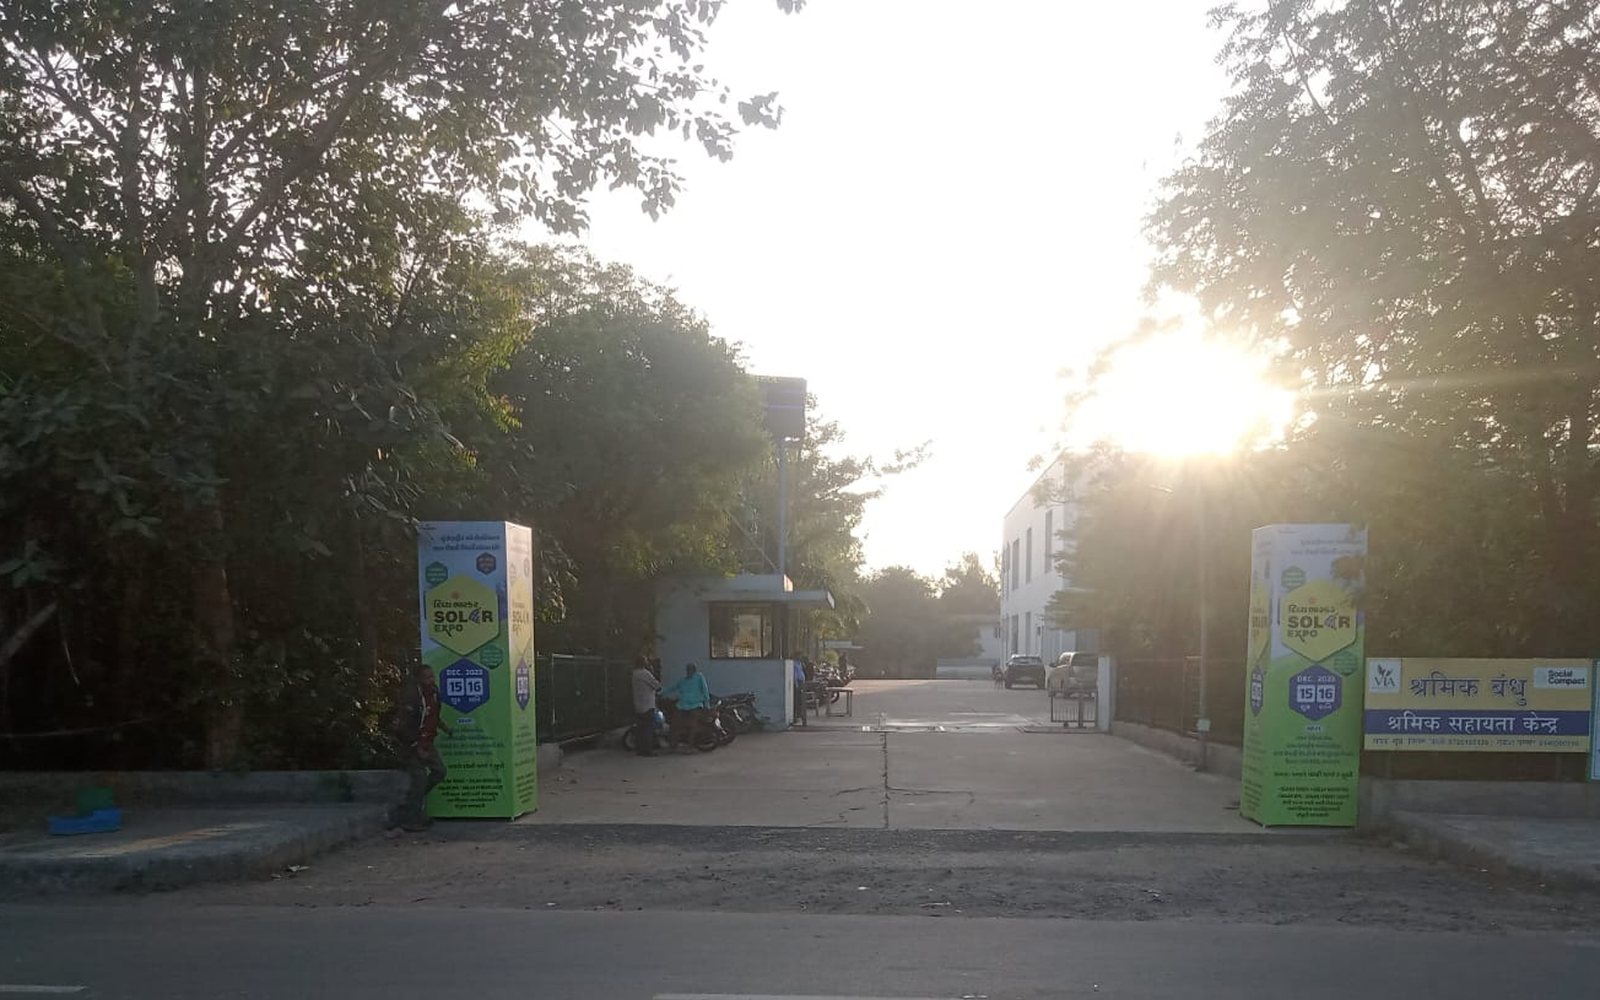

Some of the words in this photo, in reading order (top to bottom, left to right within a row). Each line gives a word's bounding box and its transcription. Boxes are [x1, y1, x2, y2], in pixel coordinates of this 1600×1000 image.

[434, 622, 464, 637] EXPO
[1287, 629, 1318, 642] EXPO
[1547, 669, 1573, 678] Social
[449, 681, 463, 693] 15
[467, 681, 482, 693] 16
[1374, 676, 1396, 687] VIA
[1547, 677, 1586, 686] Compact
[1300, 688, 1314, 699] 15
[1318, 688, 1333, 699] 16
[1410, 670, 1480, 698] श्रमिक
[1491, 673, 1528, 707] बंधु
[1387, 711, 1441, 730] श्रमिक
[1448, 716, 1516, 734] सहायता
[1522, 711, 1559, 734] केन्द्र
